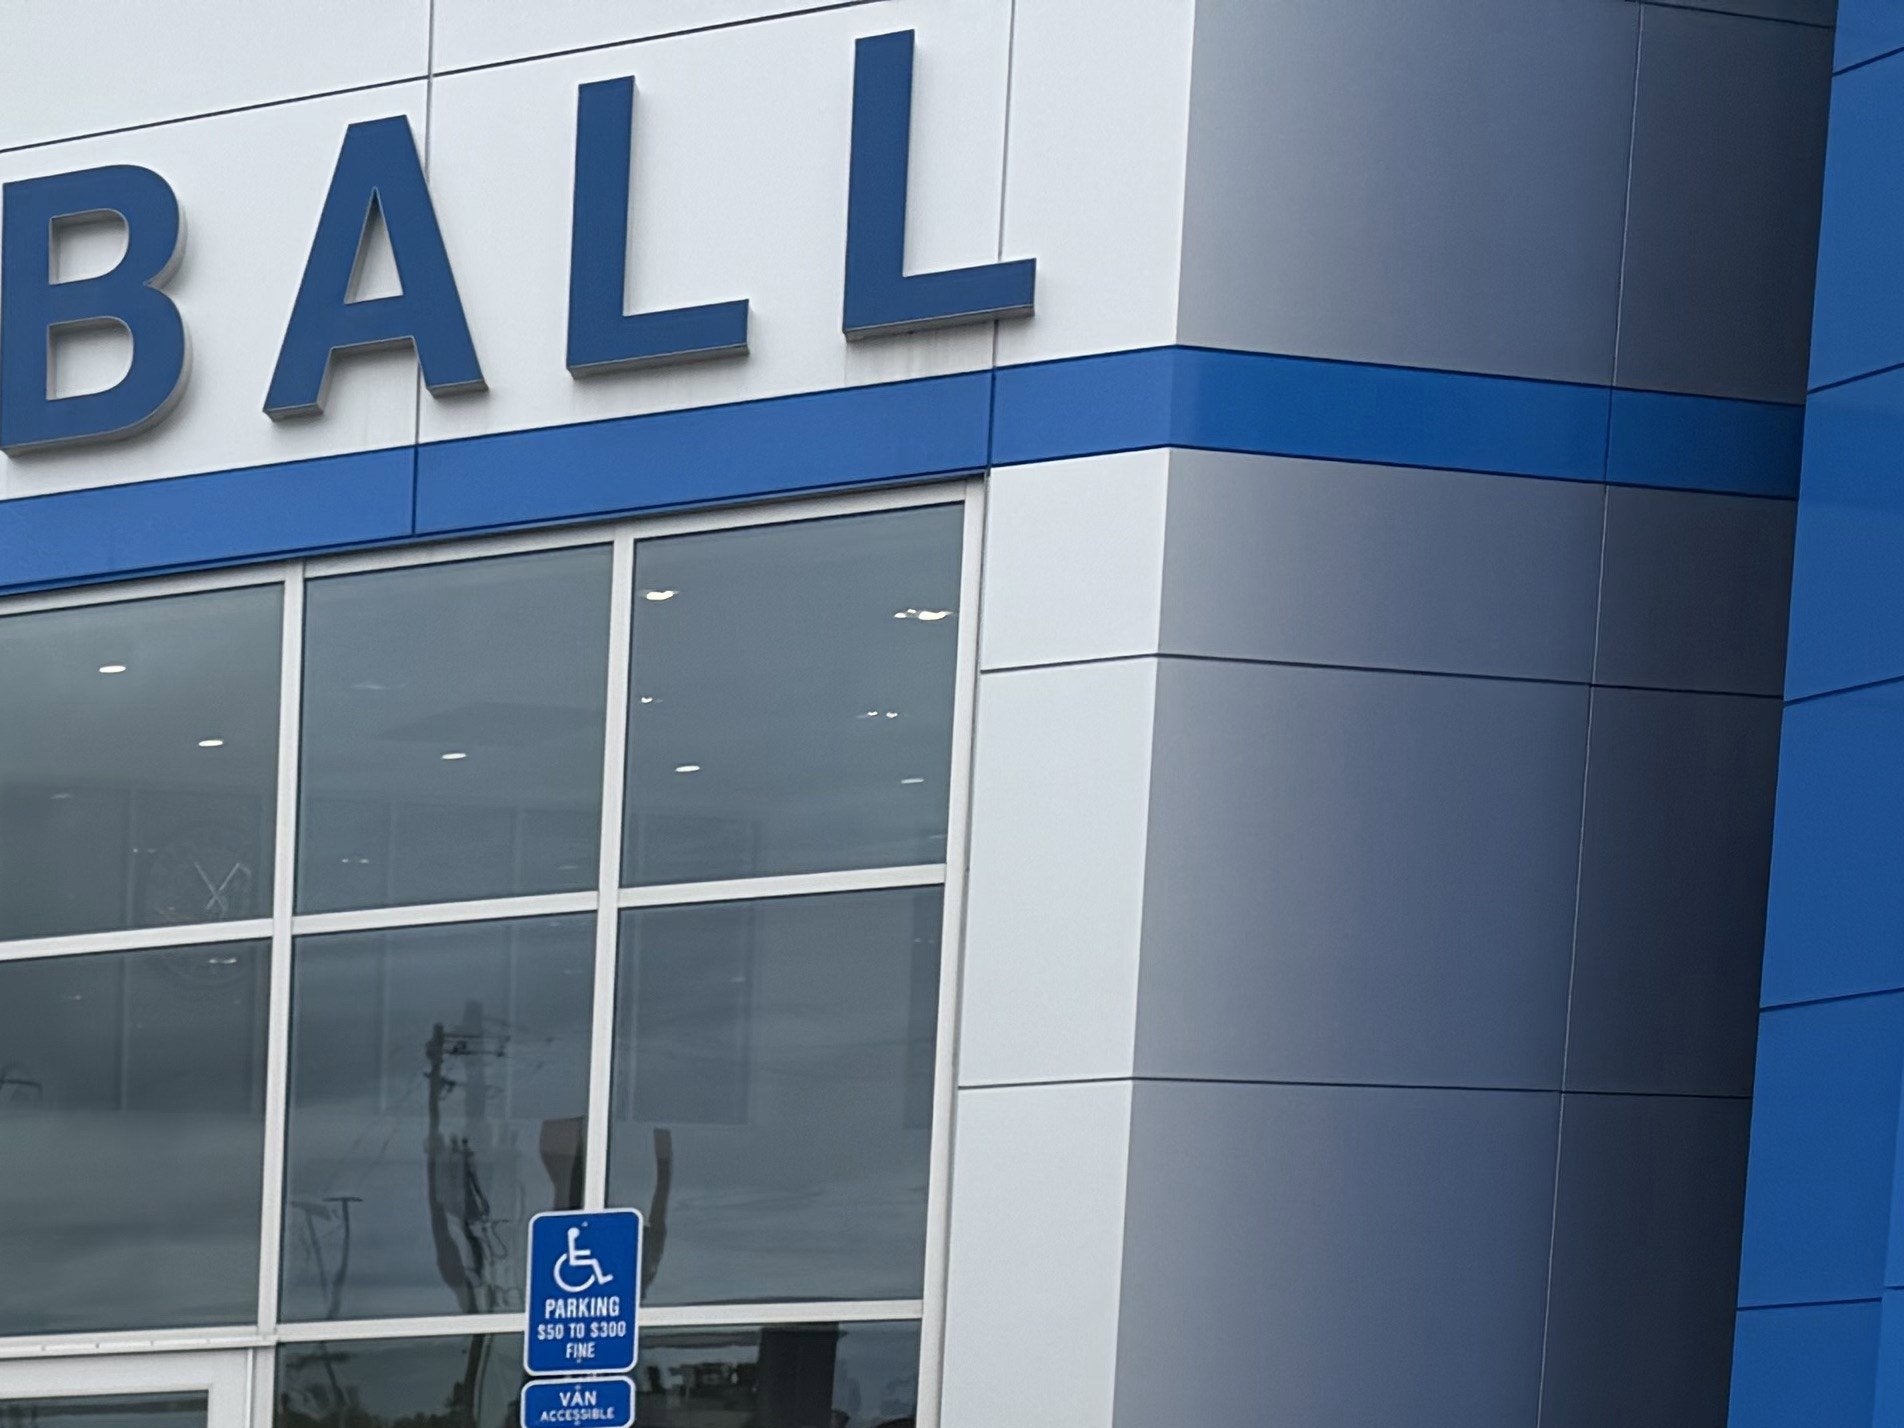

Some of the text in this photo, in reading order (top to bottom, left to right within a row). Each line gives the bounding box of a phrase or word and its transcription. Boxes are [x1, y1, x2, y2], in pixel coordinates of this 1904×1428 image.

[544, 1296, 620, 1319] PARKING
[537, 1321, 626, 1340] $50 TO $300
[565, 1342, 595, 1359] FINE
[559, 1391, 597, 1407] VAN
[540, 1407, 614, 1422] ACCESSIBLE
